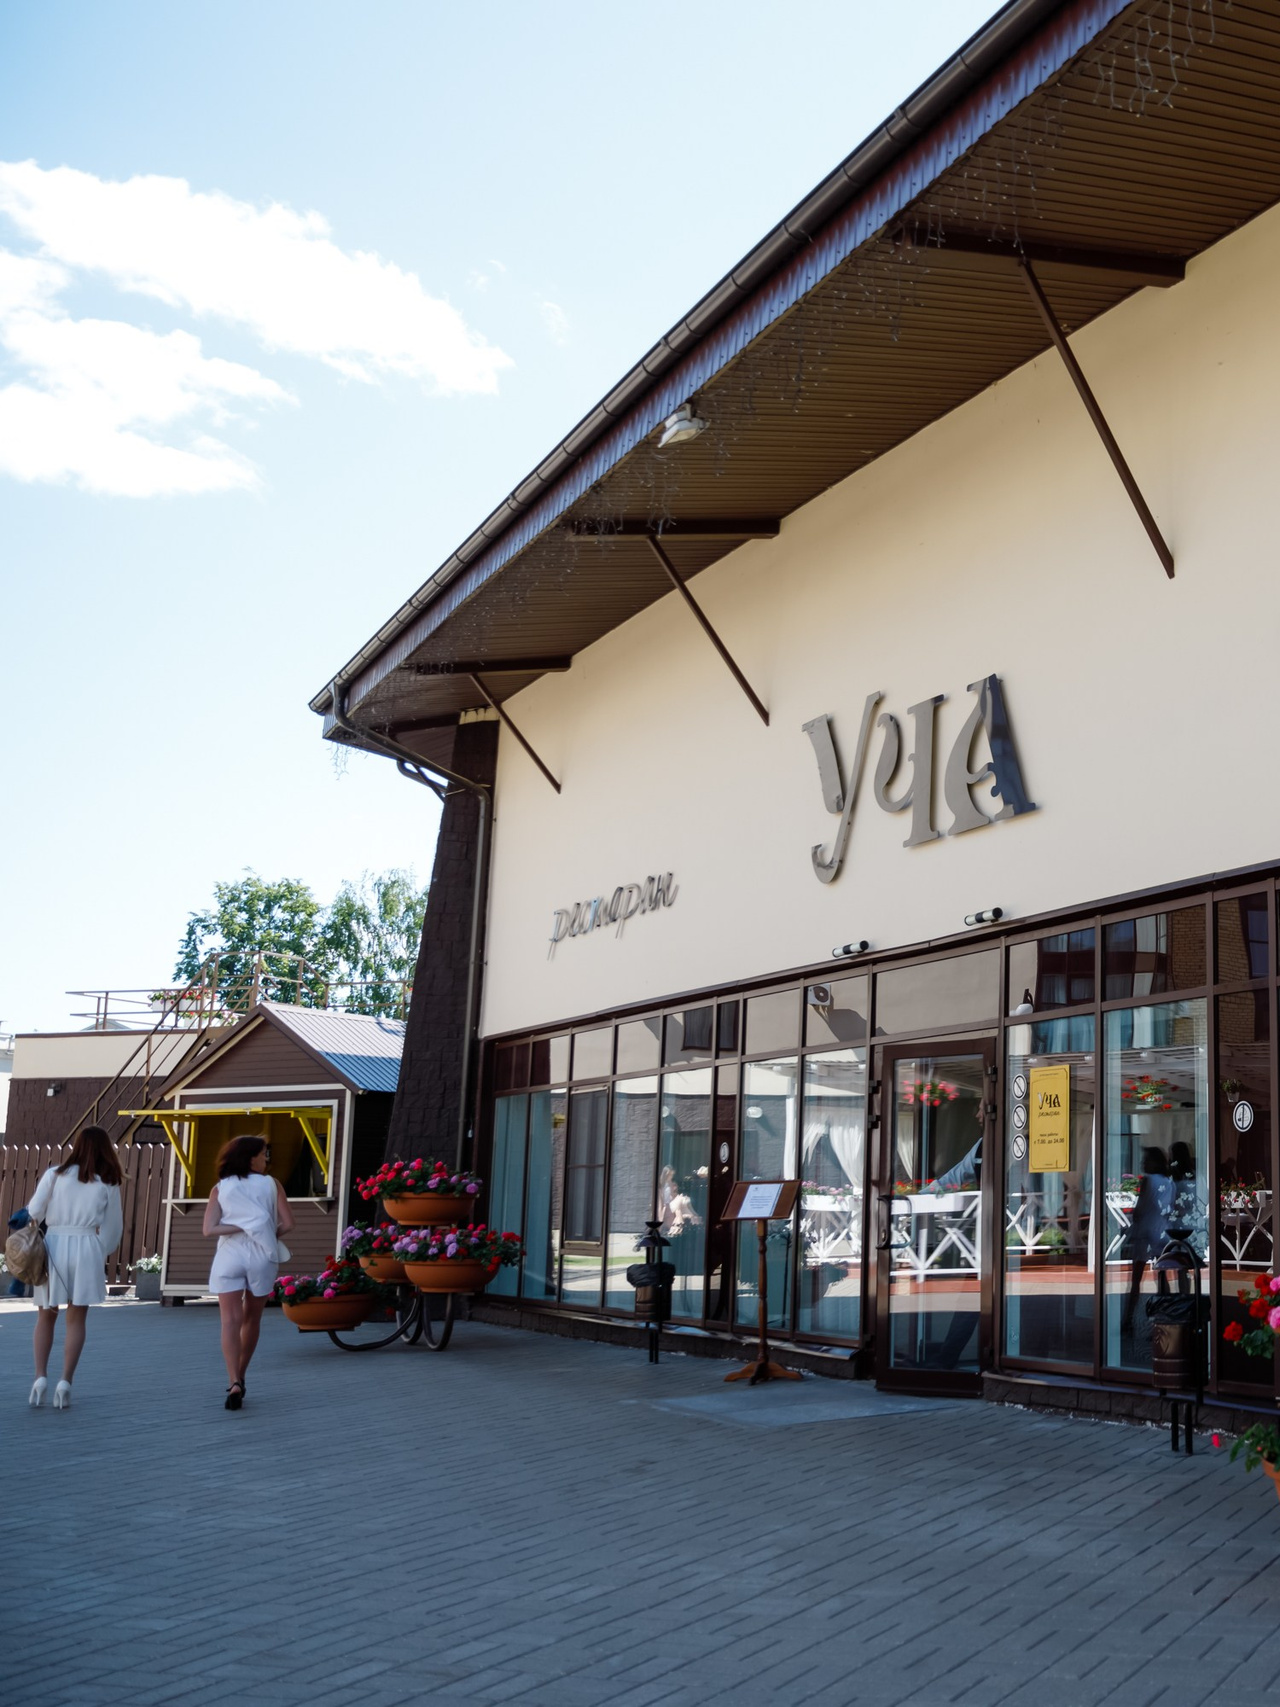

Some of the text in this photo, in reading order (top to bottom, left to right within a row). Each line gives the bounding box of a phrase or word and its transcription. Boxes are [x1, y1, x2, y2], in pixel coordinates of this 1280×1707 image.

[801, 673, 1037, 884] УЧА
[547, 871, 680, 961] ресторан
[1037, 1091, 1061, 1110] УЧА
